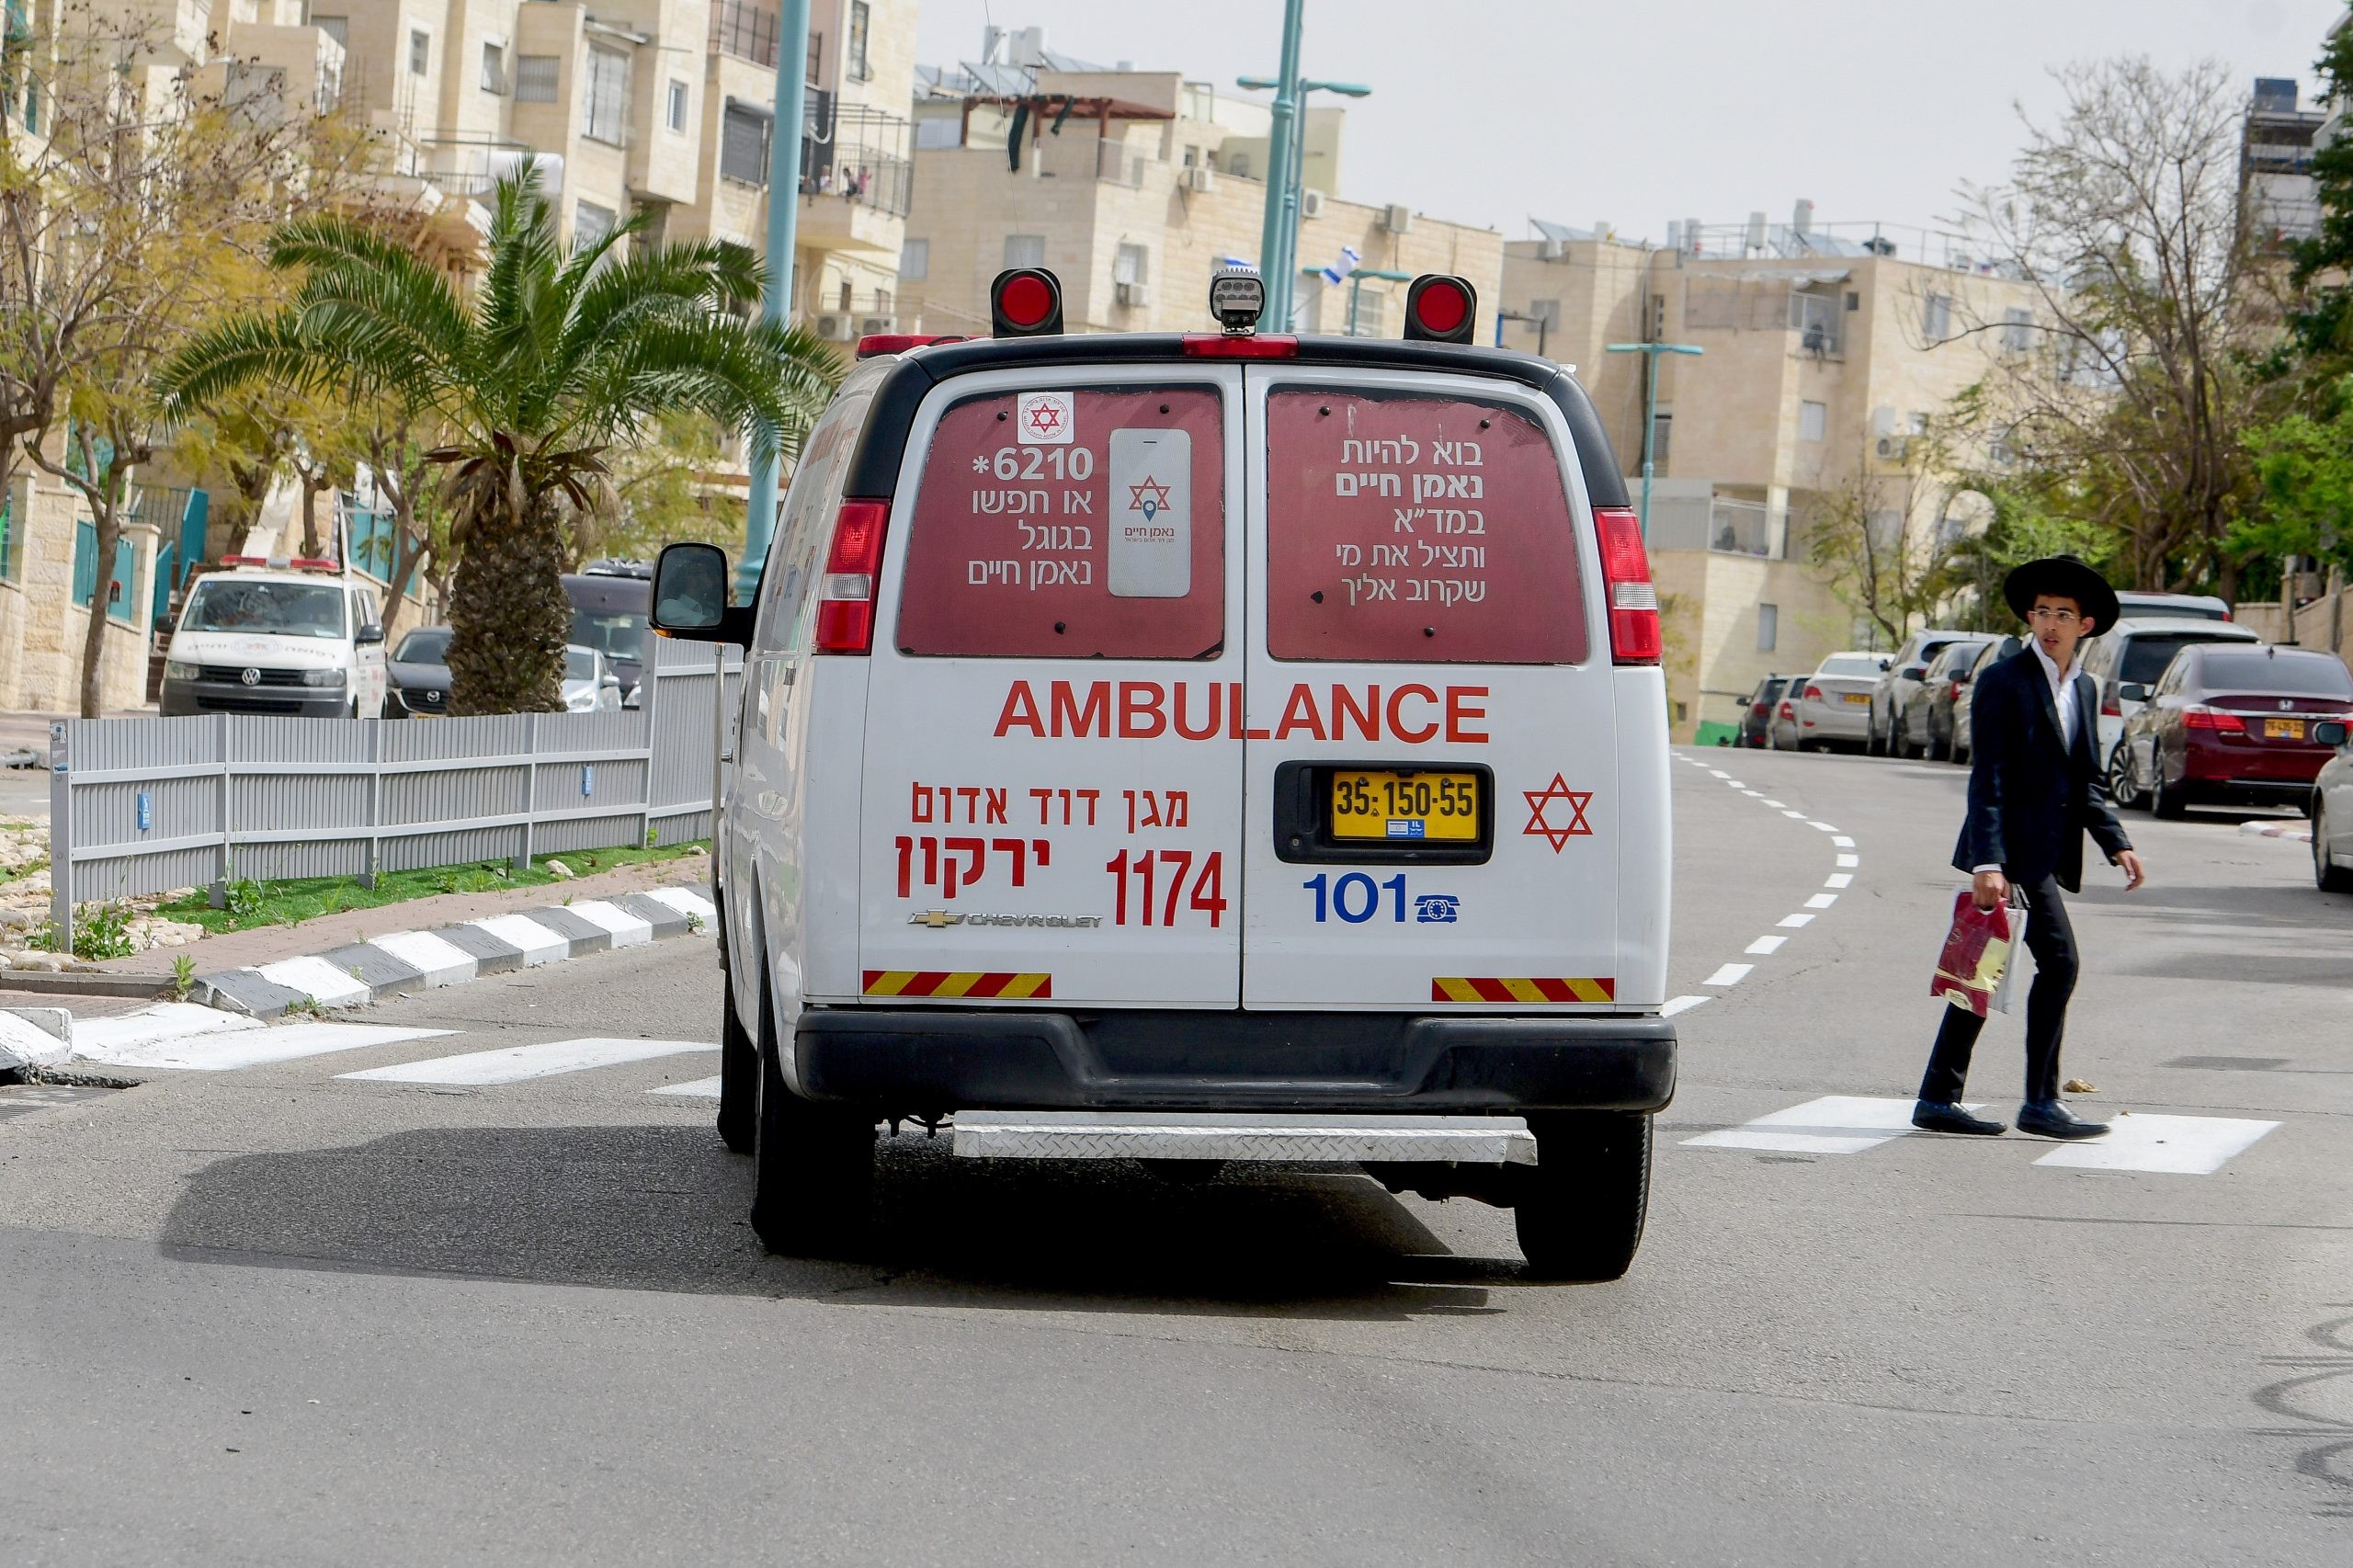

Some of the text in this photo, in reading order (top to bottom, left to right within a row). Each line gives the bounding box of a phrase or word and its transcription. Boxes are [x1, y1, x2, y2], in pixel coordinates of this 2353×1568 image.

[1340, 434, 1483, 467] בוא להיות
[972, 489, 1093, 515] או חפשו
[1336, 472, 1483, 504] נאמן חיים
[1017, 519, 1093, 551] בגוגל
[1124, 527, 1175, 538] נאמן חיים
[1336, 540, 1486, 568] ותציל את מי
[968, 560, 1092, 591] נאמן חיים
[1341, 574, 1486, 608] שקרוב אליך
[993, 680, 1490, 743] AMBULANCE
[911, 781, 1189, 835] מגן דוד אדום
[894, 835, 1228, 928] 1174 ירקון
[1299, 871, 1406, 924] 101
[967, 913, 1104, 928] CHEVROLET
